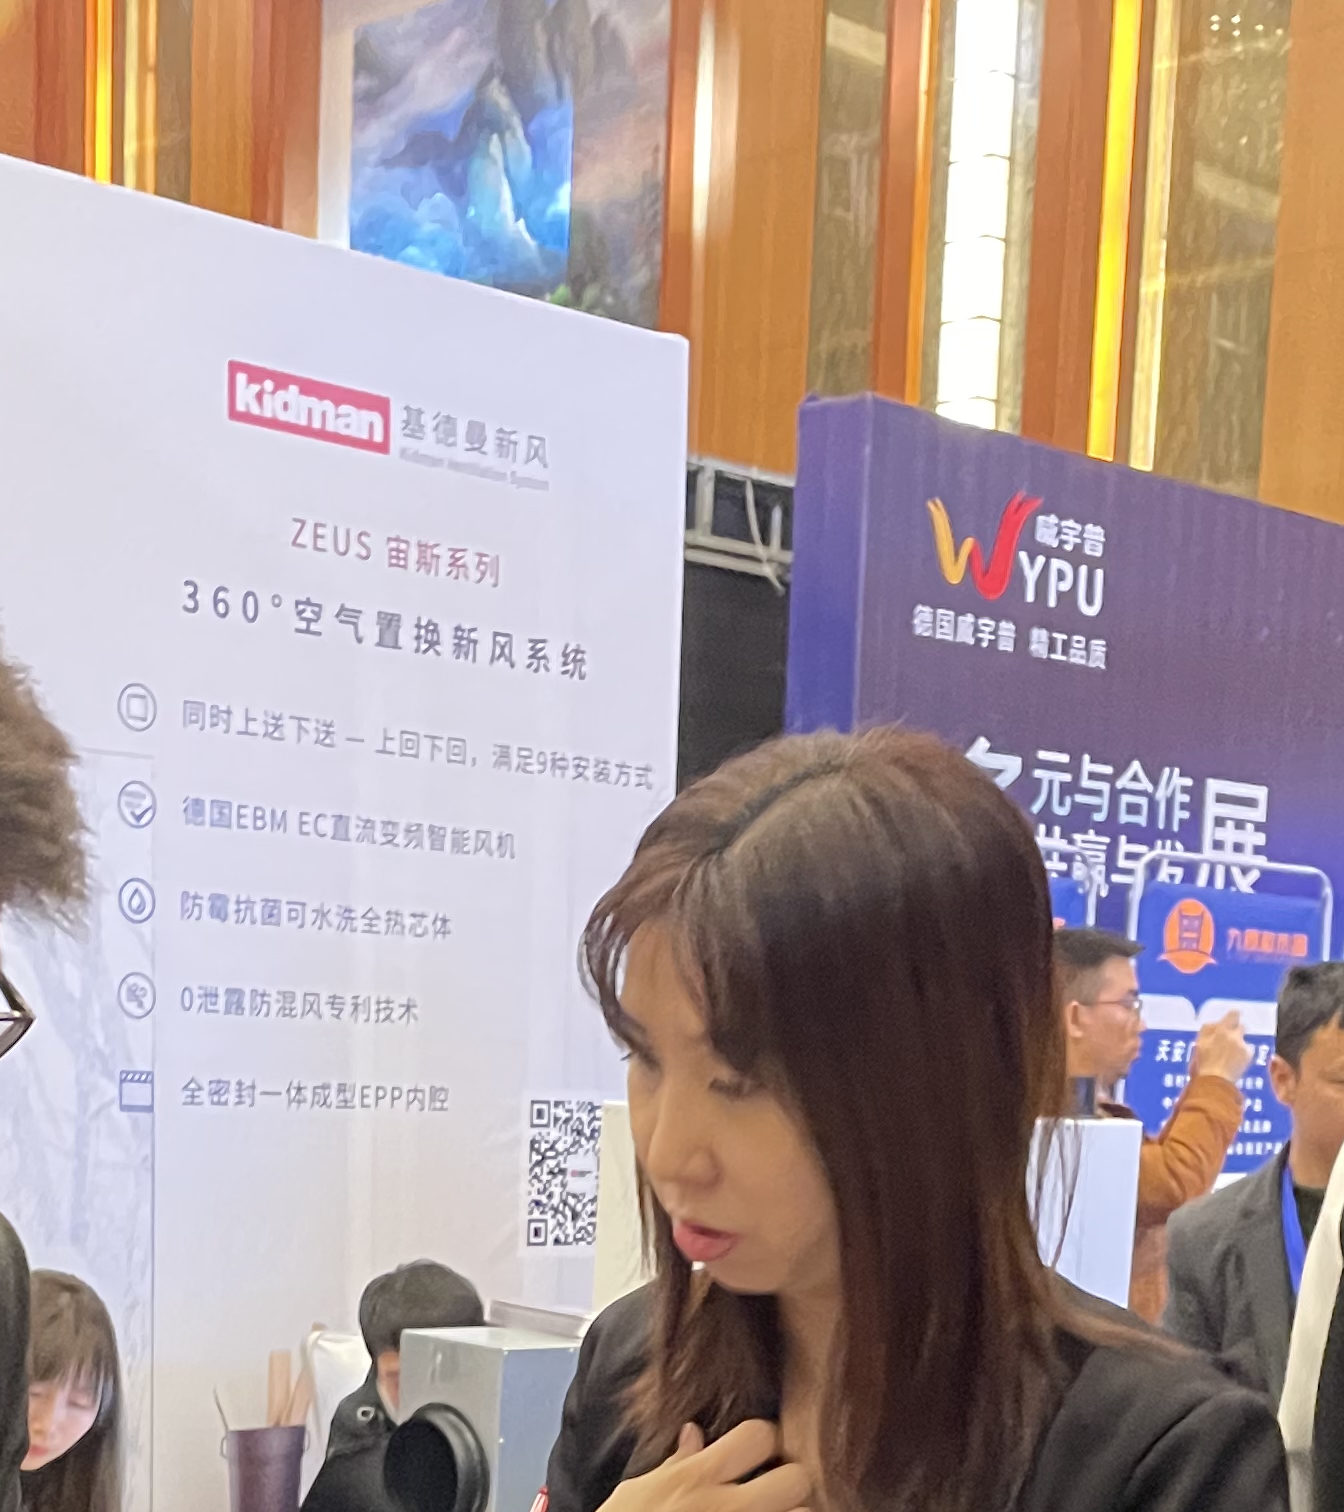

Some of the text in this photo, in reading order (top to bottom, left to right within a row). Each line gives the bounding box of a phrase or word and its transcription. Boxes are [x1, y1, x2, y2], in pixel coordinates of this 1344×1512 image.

[235, 372, 384, 443] kidman
[401, 404, 549, 469] 基德曼新风
[290, 517, 501, 588] ZEUS 宙斯系列
